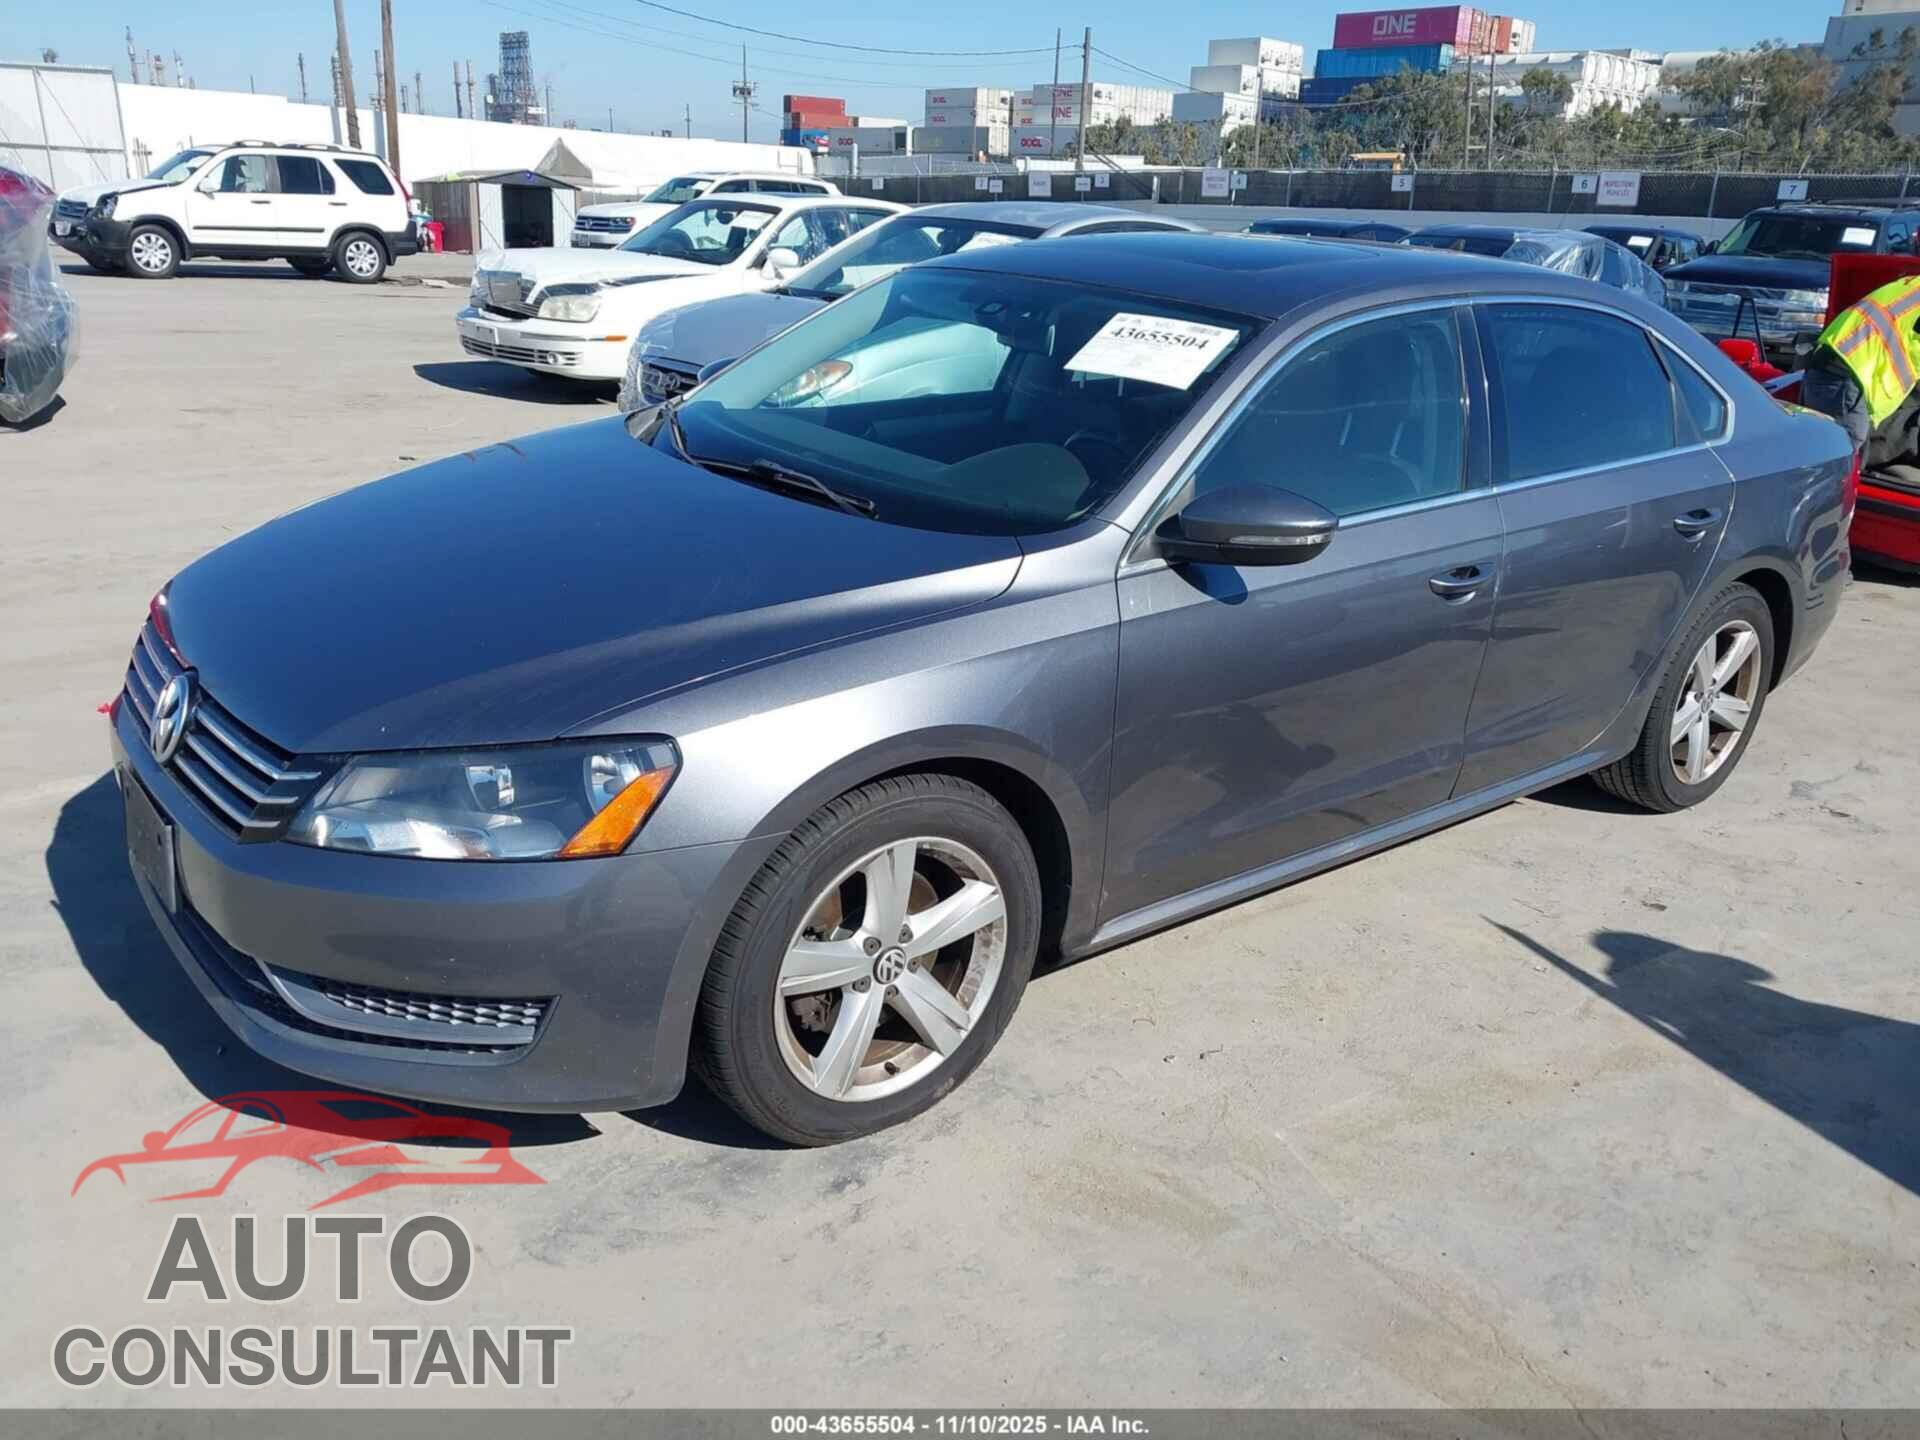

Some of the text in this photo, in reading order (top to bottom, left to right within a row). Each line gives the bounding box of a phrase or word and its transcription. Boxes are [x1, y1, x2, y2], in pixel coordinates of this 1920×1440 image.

[1372, 14, 1417, 36] ONE
[1581, 179, 1588, 190] 6
[1790, 184, 1797, 195] 7
[1110, 325, 1212, 350] 43655504
